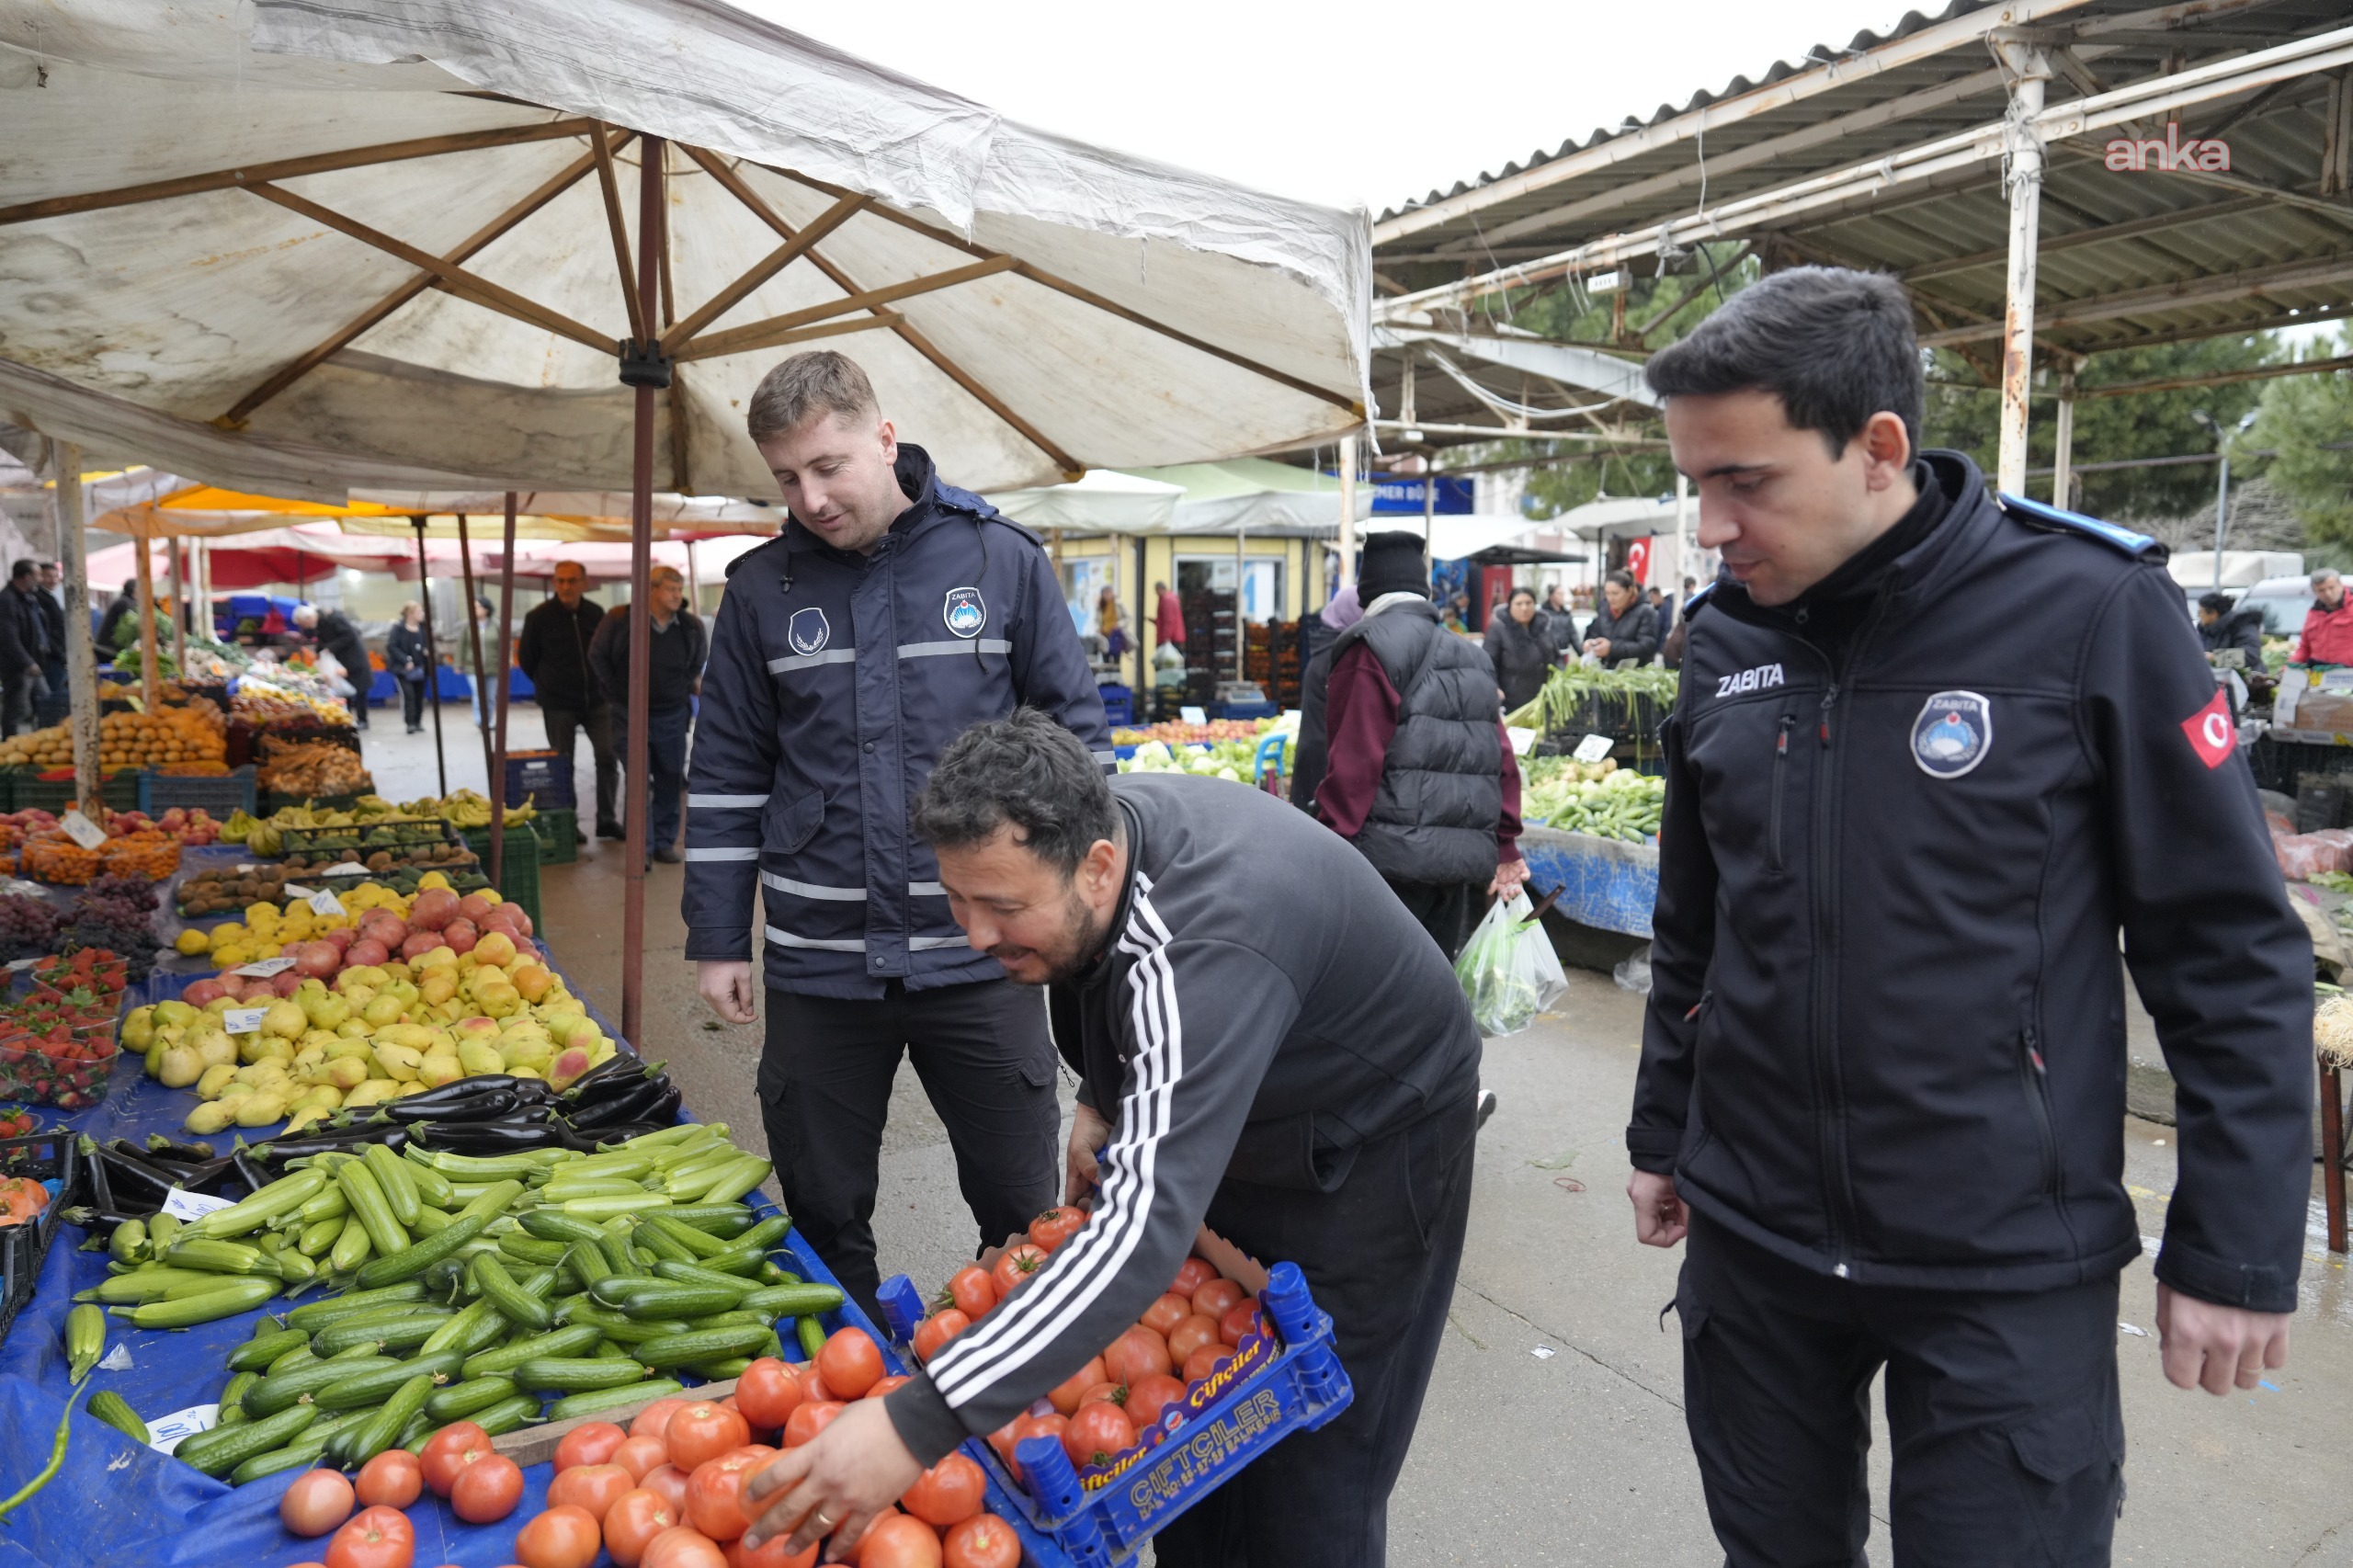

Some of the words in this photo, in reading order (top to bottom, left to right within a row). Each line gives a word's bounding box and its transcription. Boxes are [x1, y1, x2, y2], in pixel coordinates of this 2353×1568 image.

[1374, 484, 1404, 501] MER
[1405, 483, 1440, 502] BÜE
[951, 592, 976, 600] ZABITA
[1715, 663, 1785, 699] ZABITA
[1932, 699, 1979, 712] ZABITA
[1190, 1339, 1261, 1409] Çiftçiler
